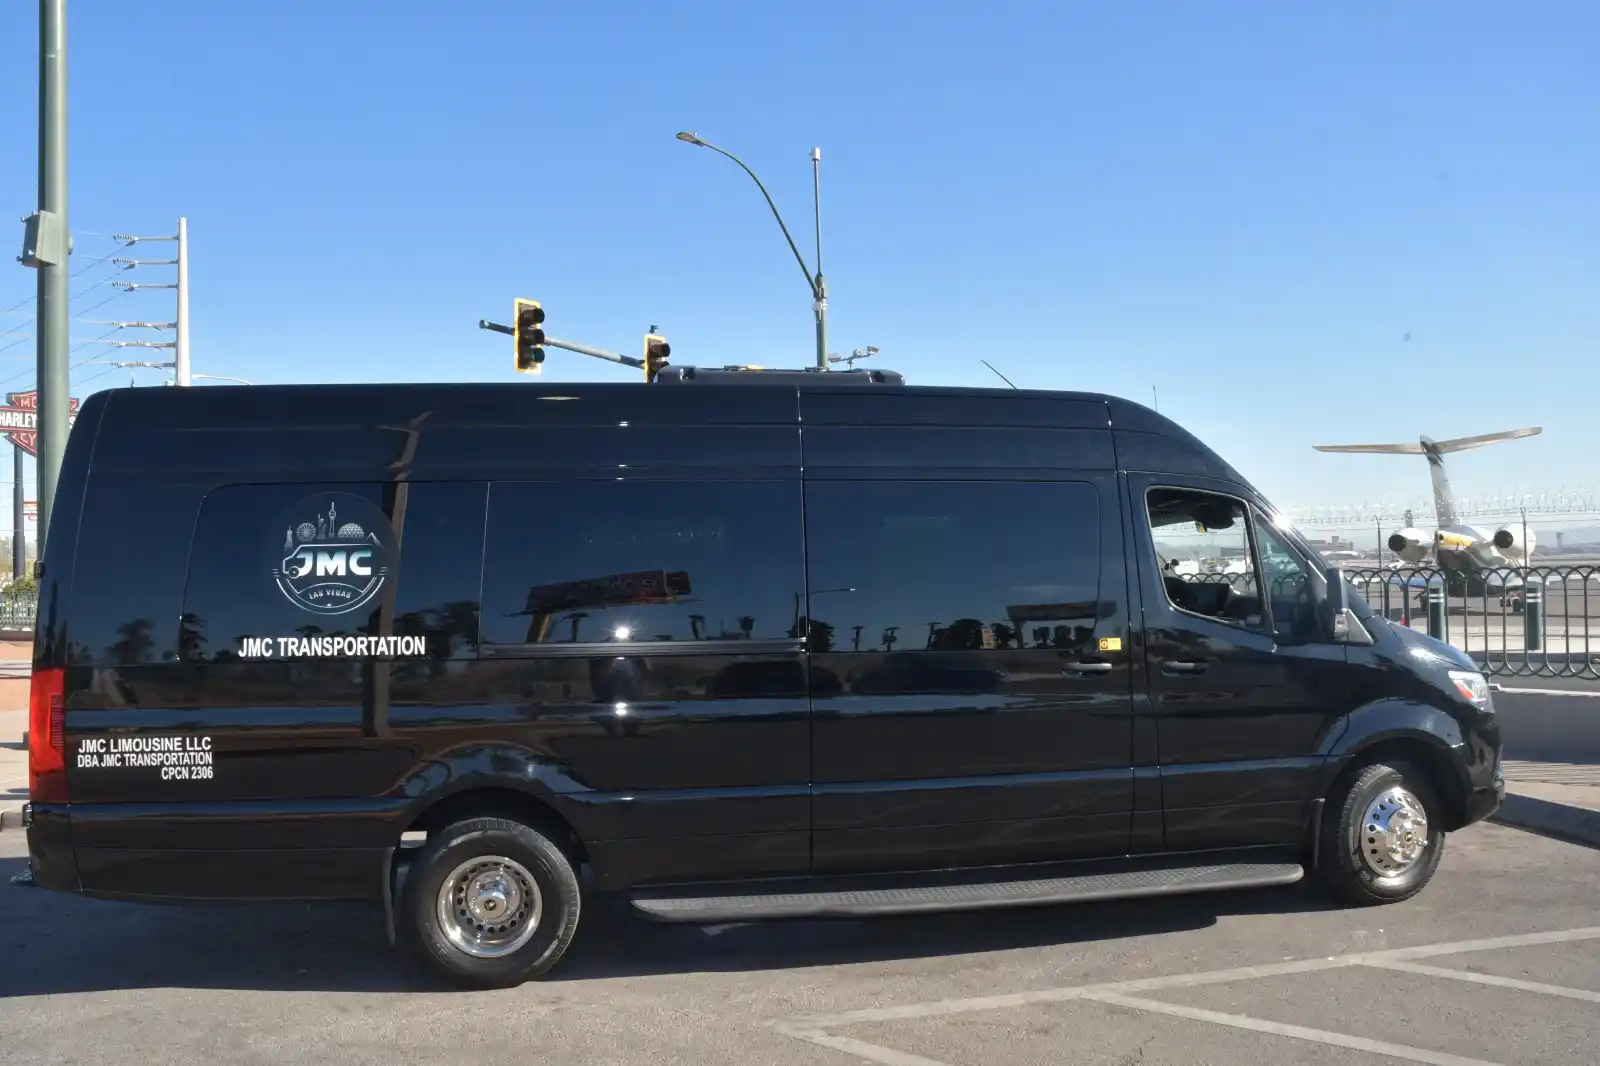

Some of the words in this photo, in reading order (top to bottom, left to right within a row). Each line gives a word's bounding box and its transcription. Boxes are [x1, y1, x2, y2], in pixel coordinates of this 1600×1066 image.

[297, 551, 372, 577] JMC
[308, 589, 324, 600] LAS
[326, 589, 352, 599] VEGAS
[238, 637, 273, 657] JMC
[277, 636, 426, 657] TRANSPORTATION
[78, 738, 107, 753] JMC
[109, 737, 183, 753] LIMOUSINE
[185, 736, 212, 751] LLC
[77, 753, 100, 768] DBA
[100, 753, 122, 767] JMC
[124, 751, 213, 767] TRANSPORTATION
[161, 766, 190, 780] CPCN
[191, 765, 214, 779] 2306
